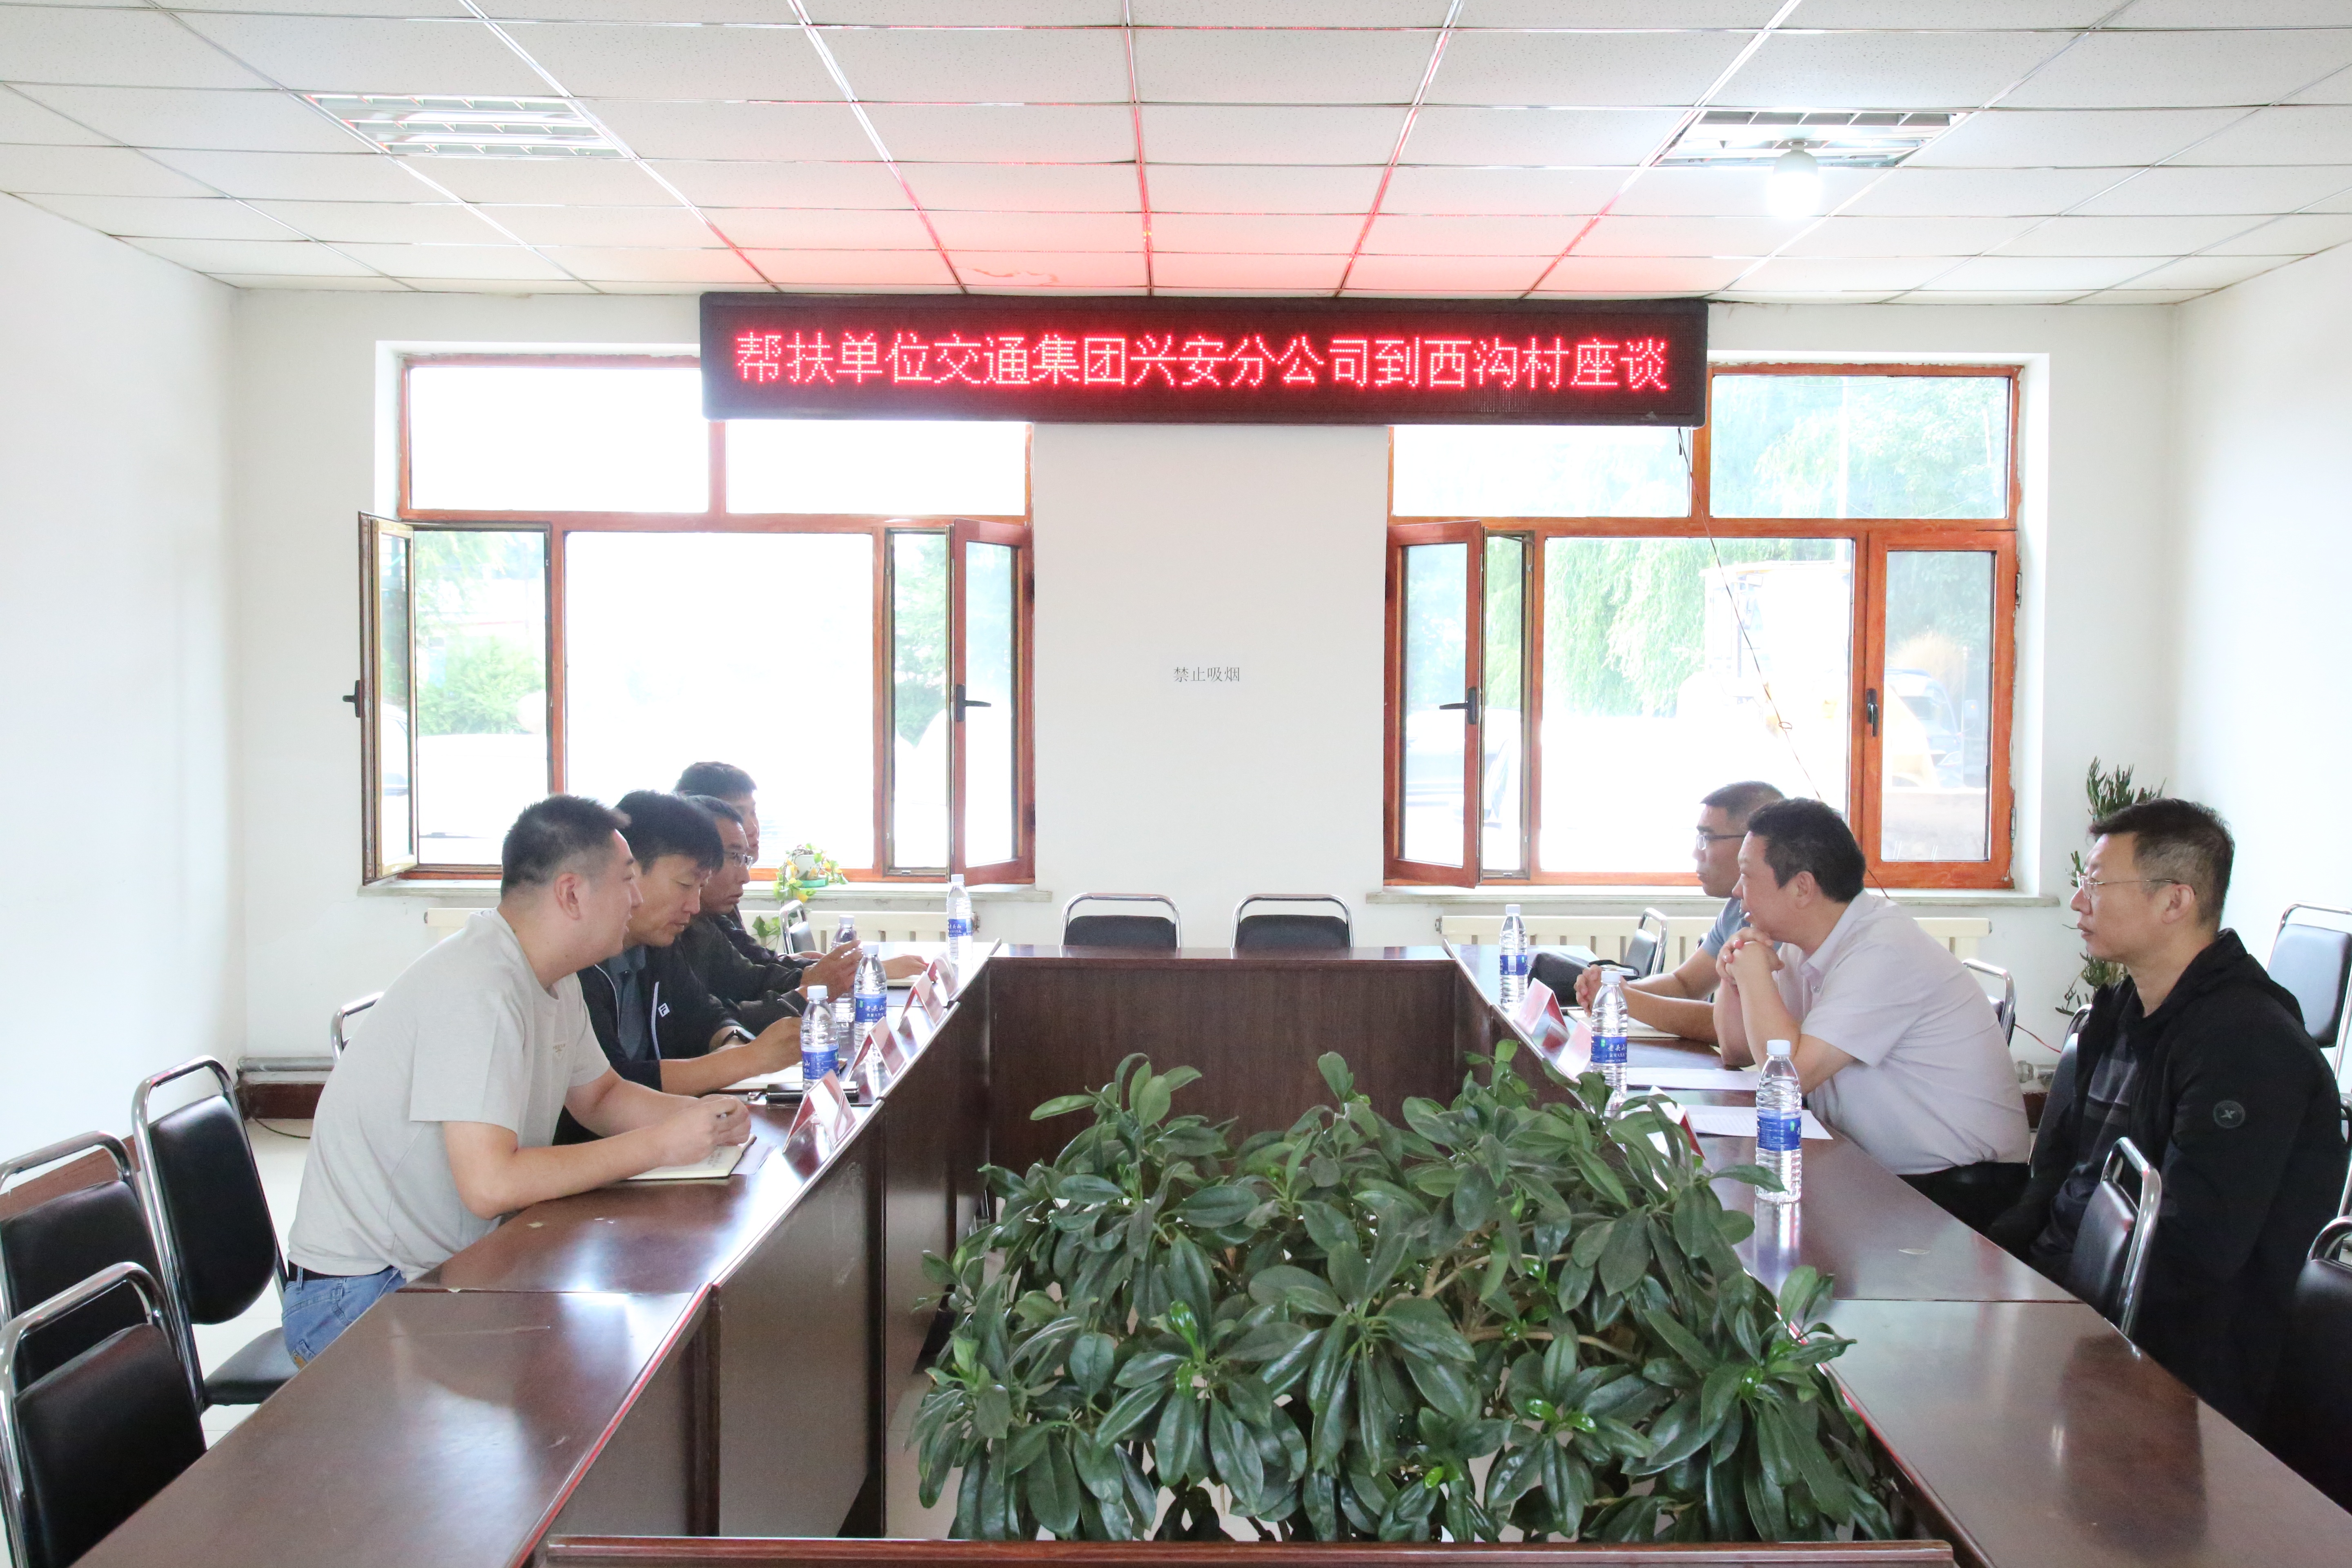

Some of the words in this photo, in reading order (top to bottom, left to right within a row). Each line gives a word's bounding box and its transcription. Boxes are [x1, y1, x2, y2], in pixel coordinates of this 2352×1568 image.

[737, 331, 1668, 390] 帮扶单位交通集团兴安分公司到西沟村座谈
[1173, 666, 1240, 682] 禁止吸烟
